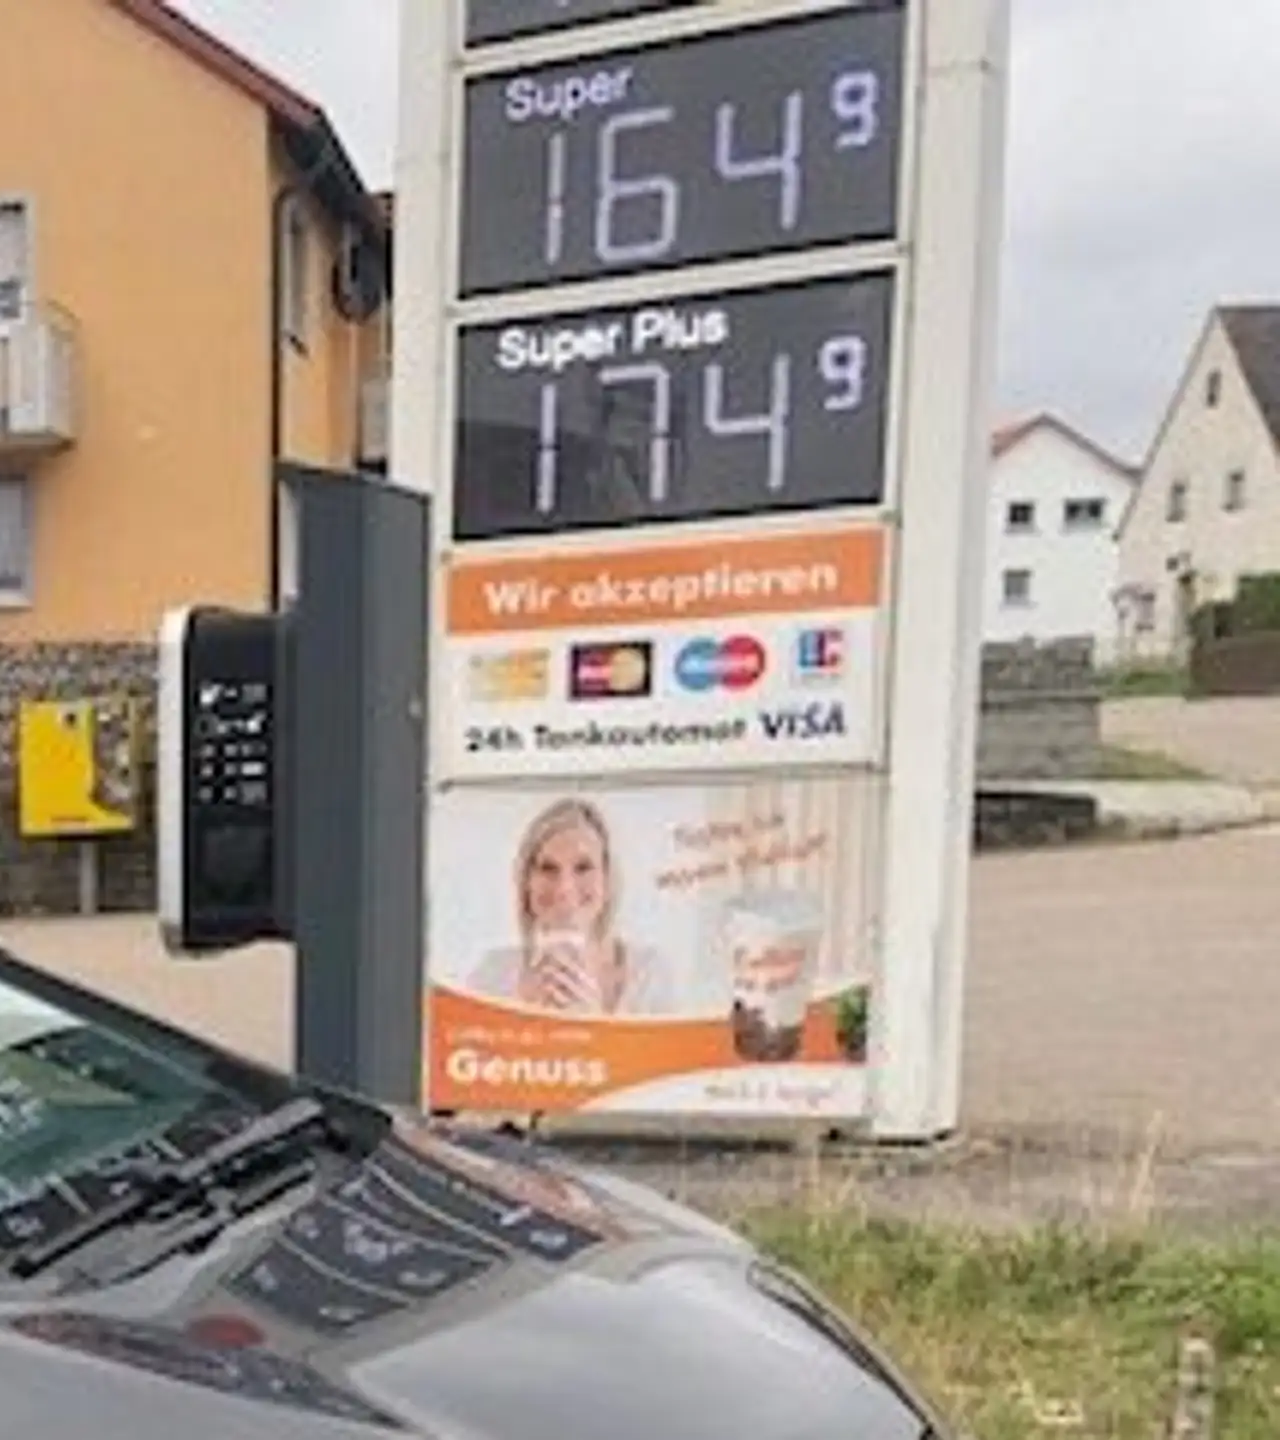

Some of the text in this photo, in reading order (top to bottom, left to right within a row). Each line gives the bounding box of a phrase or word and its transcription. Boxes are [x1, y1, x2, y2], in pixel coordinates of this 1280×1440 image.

[505, 68, 633, 120] Super
[497, 309, 729, 371] Super Plus
[482, 560, 838, 614] Wir akzeptieren
[464, 725, 523, 753] 24h
[760, 702, 847, 739] VISA
[445, 1047, 608, 1087] Genuss
